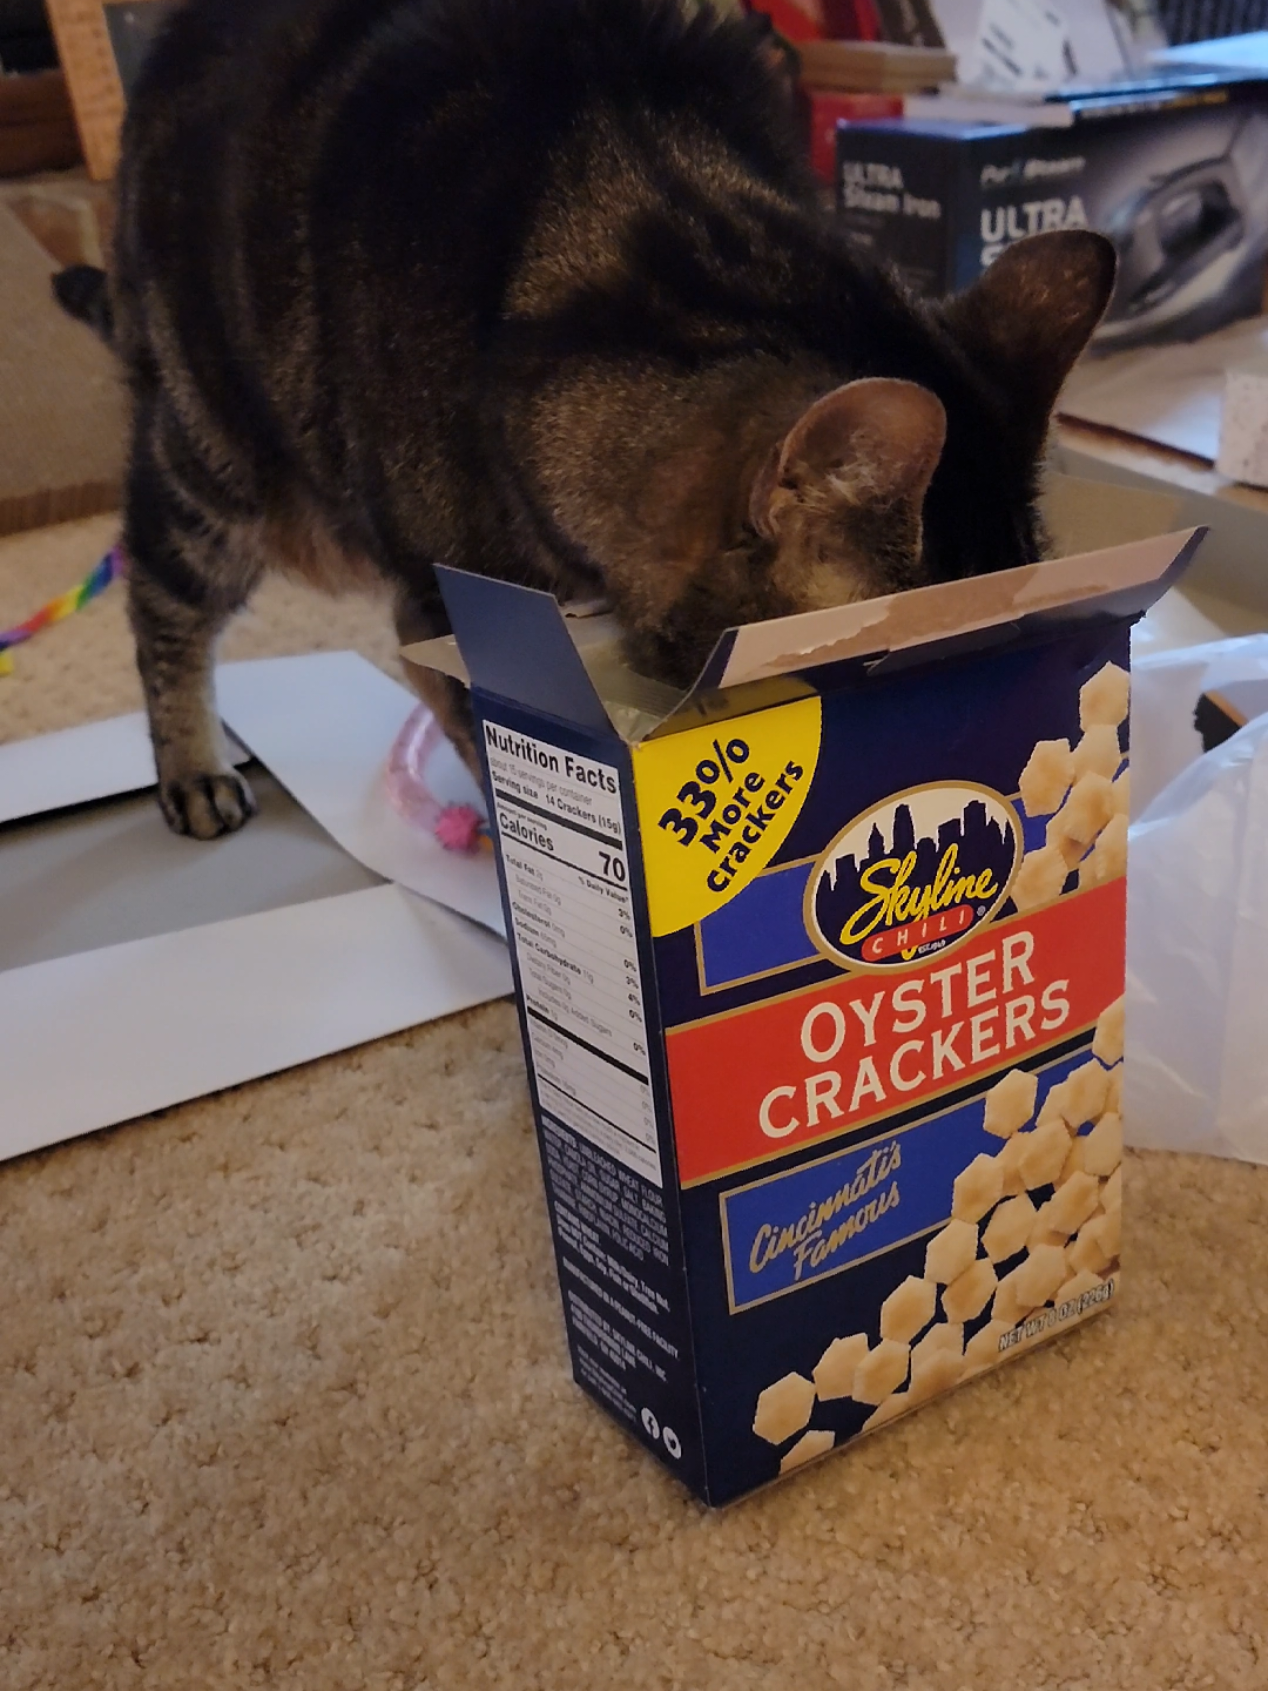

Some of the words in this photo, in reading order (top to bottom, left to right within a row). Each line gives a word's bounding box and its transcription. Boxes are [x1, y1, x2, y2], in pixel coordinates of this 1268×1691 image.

[980, 195, 1089, 243] ULTRA
[485, 724, 559, 773] Nutrition
[564, 754, 616, 795] Facts
[658, 739, 750, 846] 33%
[491, 770, 520, 793] Serving
[522, 783, 538, 799] size
[545, 793, 554, 806] 14
[556, 797, 596, 824] Crackers
[597, 813, 621, 835] (15g)
[699, 772, 765, 853] More
[498, 811, 554, 852] Calories
[598, 849, 625, 883] 70
[840, 843, 998, 957] Skyline
[872, 911, 965, 954] CHILI
[534, 942, 581, 976] Carbohydrate
[800, 930, 1035, 1063] OYSTER
[759, 979, 1070, 1138] CRACKERS
[749, 1140, 901, 1273] Cincinnati's
[794, 1181, 900, 1281] Famous
[998, 1325, 1025, 1353] NET
[1025, 1313, 1048, 1338] WT
[1058, 1299, 1078, 1322] OZ
